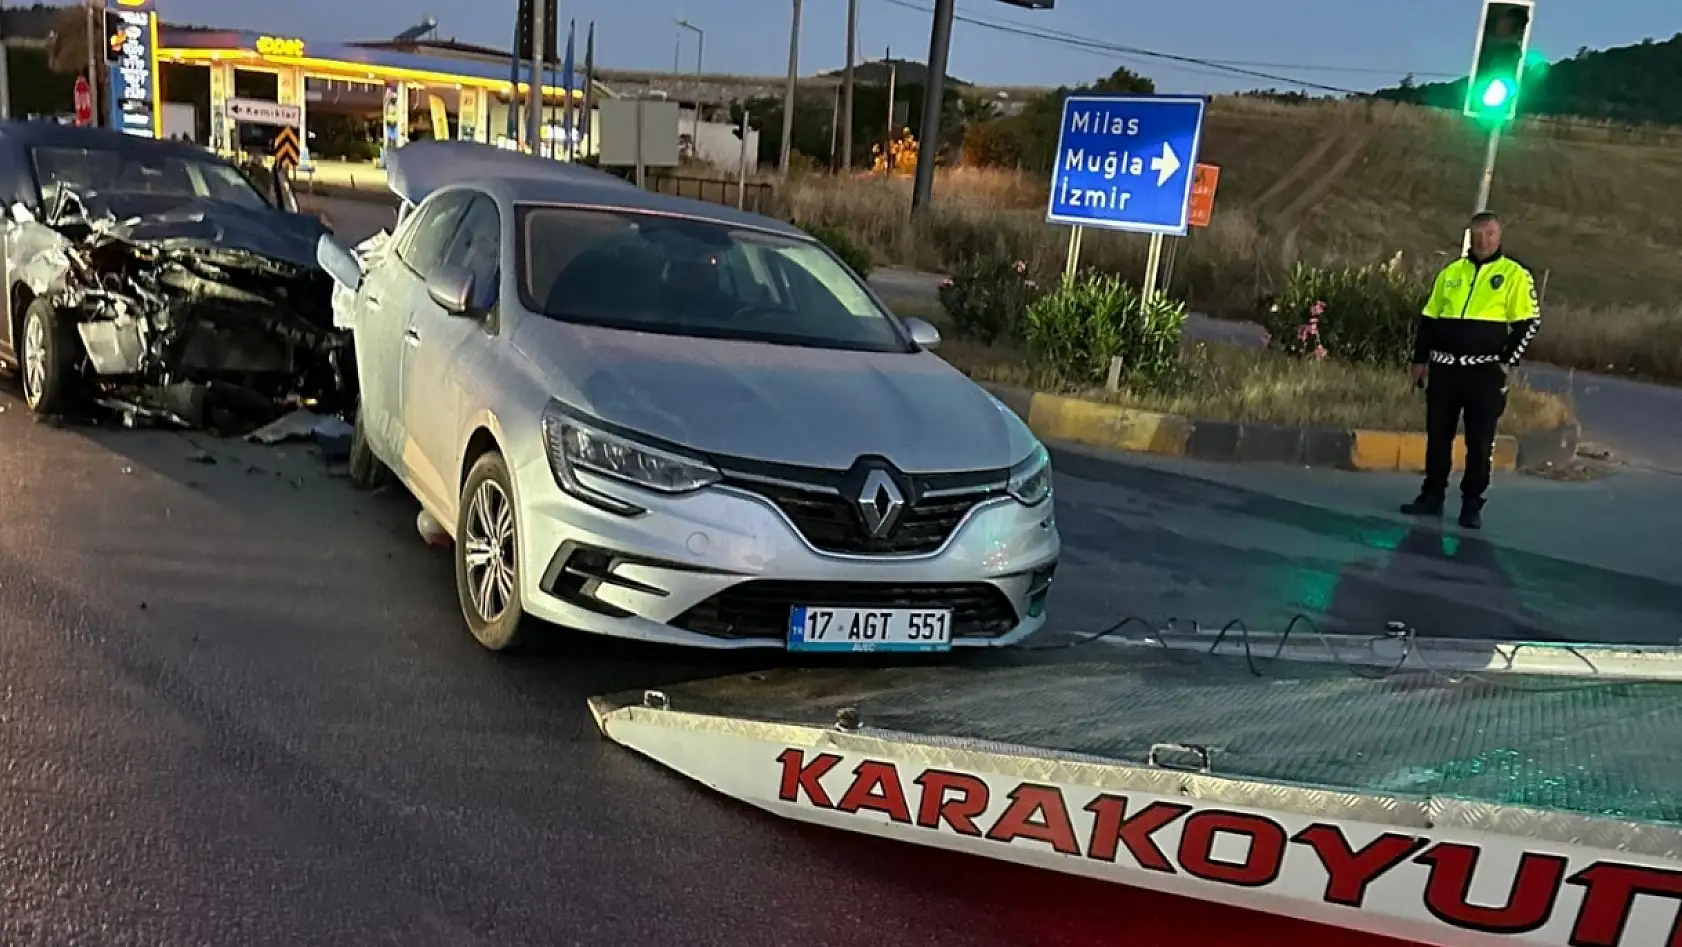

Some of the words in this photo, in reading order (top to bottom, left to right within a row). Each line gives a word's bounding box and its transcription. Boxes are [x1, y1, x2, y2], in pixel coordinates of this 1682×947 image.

[1071, 111, 1140, 136] Milas
[1065, 148, 1144, 180] Muğla
[1060, 176, 1132, 211] İzmir
[808, 612, 834, 640] 17
[848, 612, 892, 640] AGT
[907, 613, 946, 640] 551
